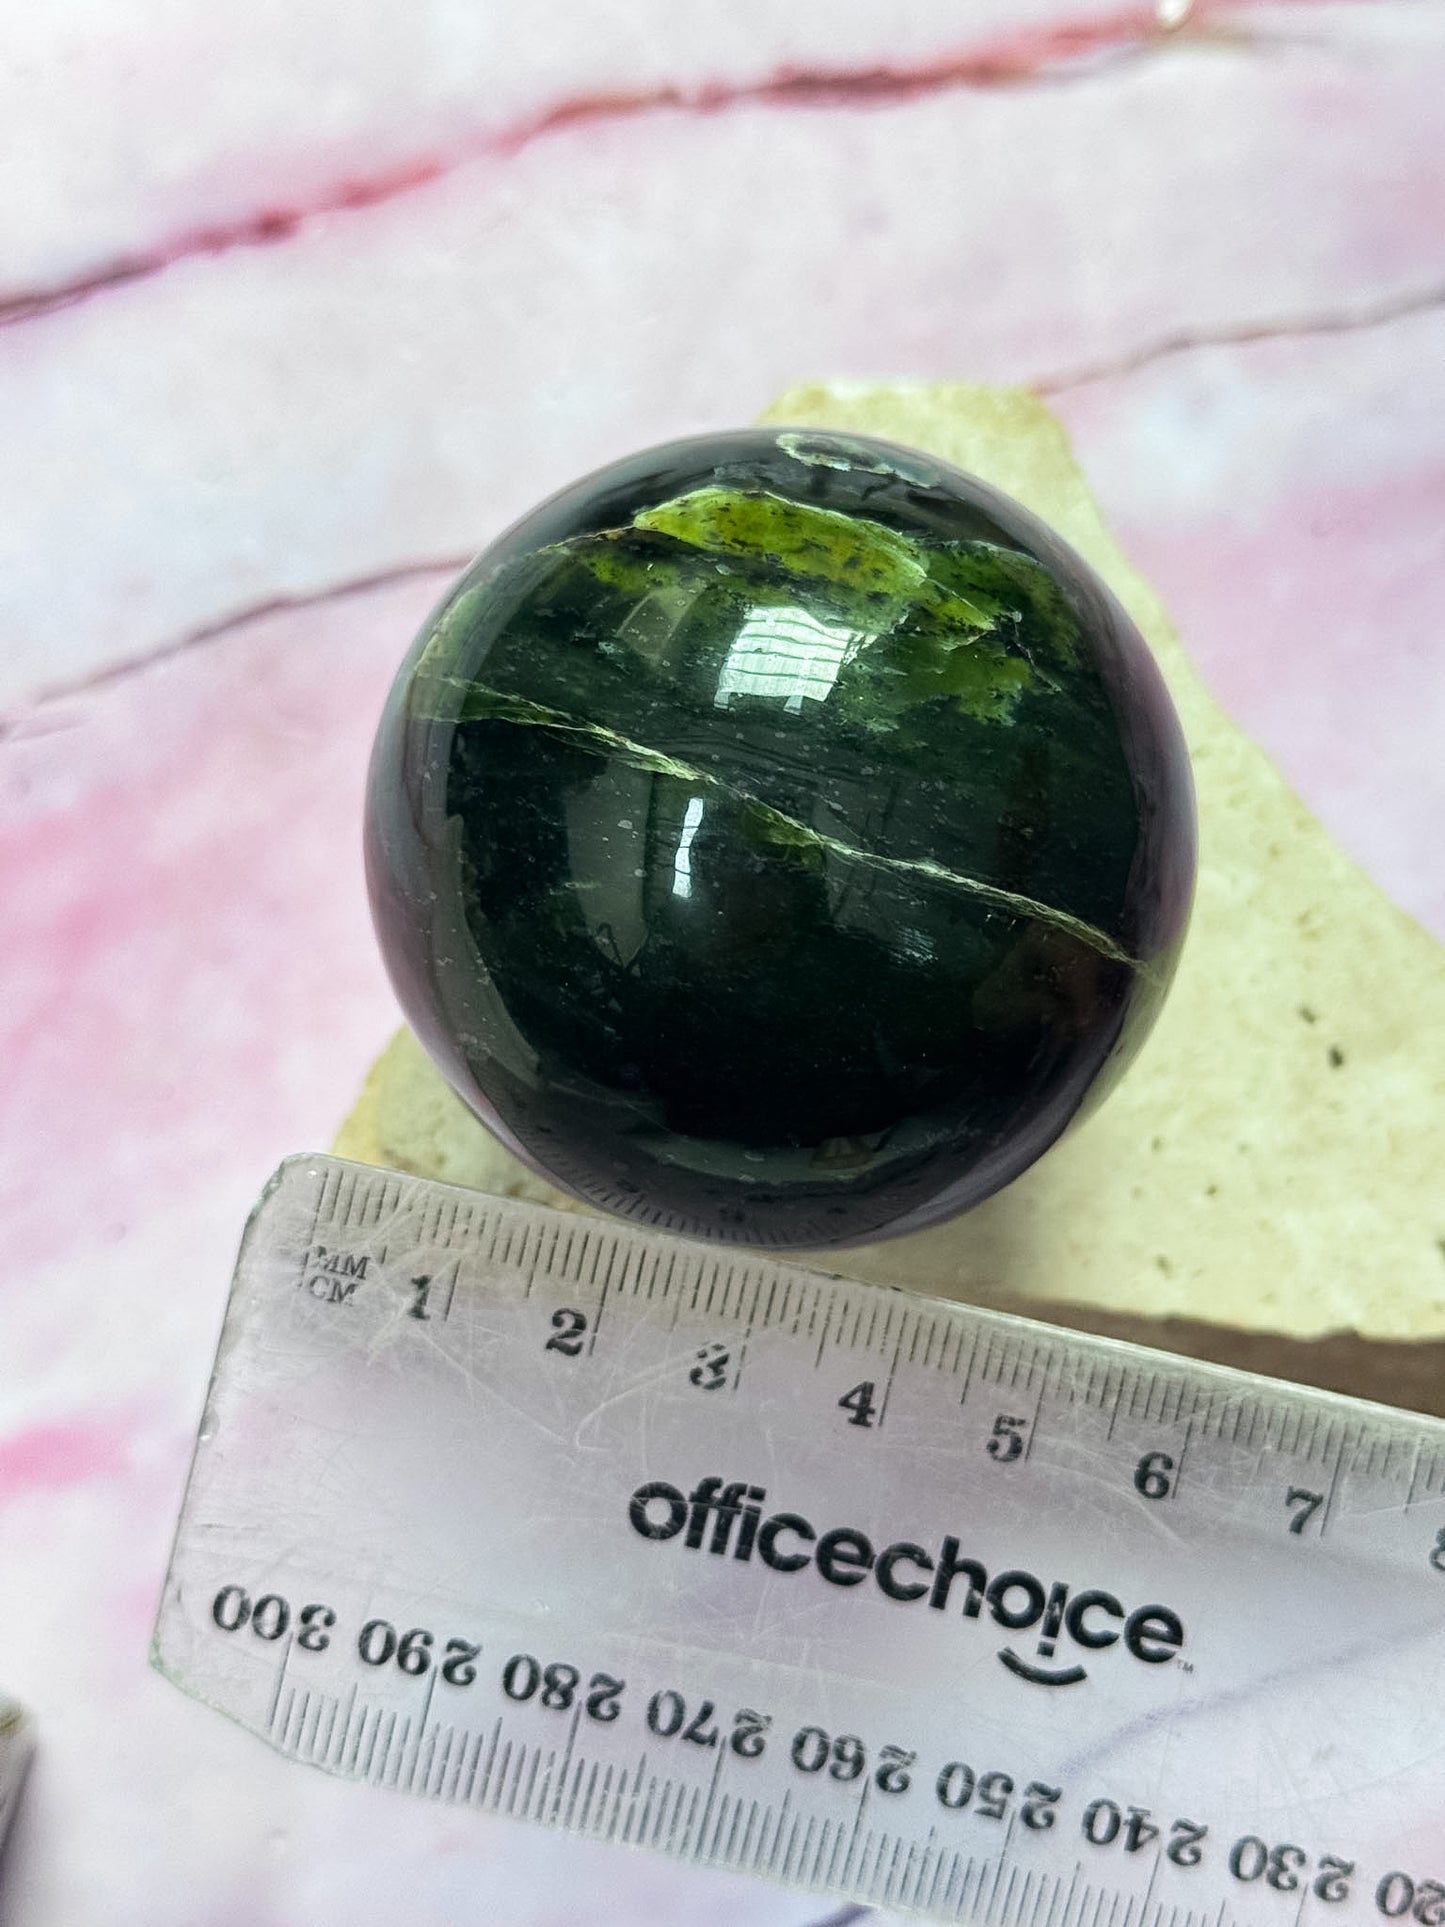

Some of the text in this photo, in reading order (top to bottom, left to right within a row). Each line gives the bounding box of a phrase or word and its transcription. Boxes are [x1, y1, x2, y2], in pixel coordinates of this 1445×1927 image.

[309, 1275, 358, 1307] CM
[407, 1274, 1324, 1534] 1 2 3 4 5 6 7
[628, 1476, 1184, 1663] officechoice
[212, 1584, 337, 1652] 300
[358, 1618, 483, 1687] 290
[502, 1653, 627, 1722] 280
[646, 1689, 773, 1758] 270
[790, 1725, 917, 1794] 260
[935, 1761, 1063, 1831] 250
[1082, 1798, 1209, 1867] 240
[1228, 1835, 1356, 1903] 230
